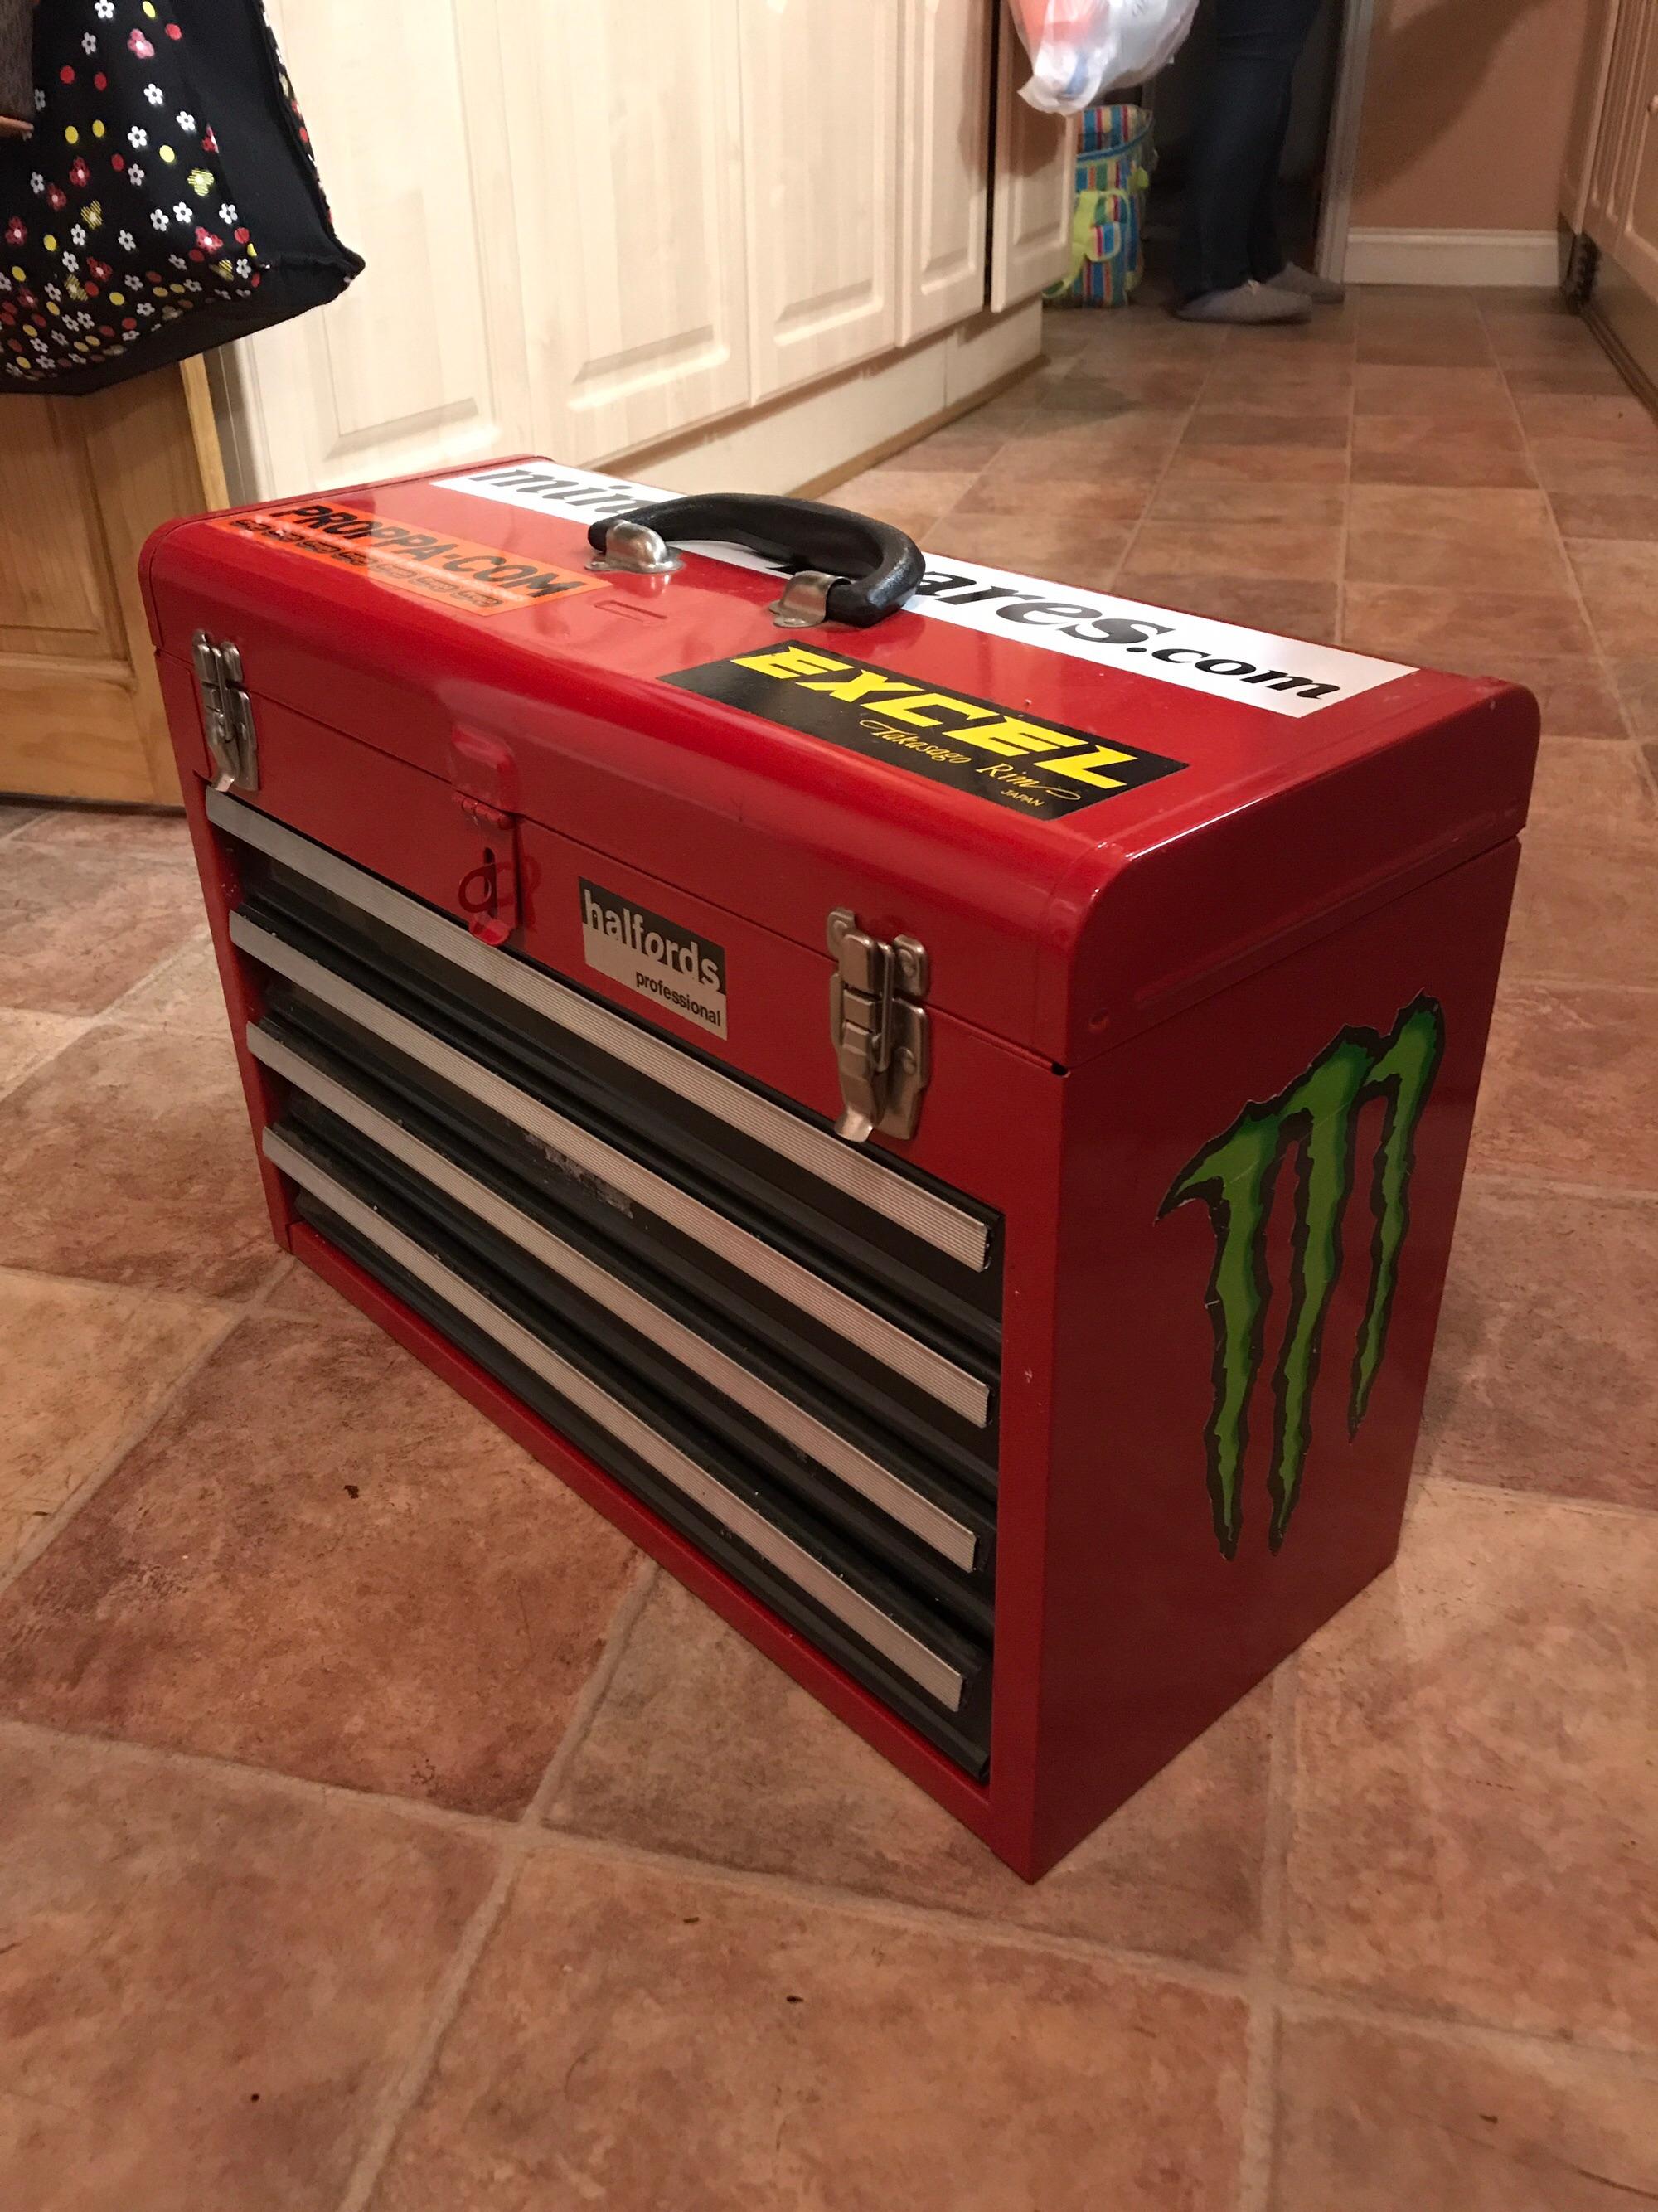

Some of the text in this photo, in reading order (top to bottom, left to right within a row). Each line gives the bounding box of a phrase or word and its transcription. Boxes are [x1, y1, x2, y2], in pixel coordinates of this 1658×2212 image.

[730, 647, 1138, 789] EXCEL
[859, 720, 972, 764] Takasago
[1001, 789, 1045, 807] JAPAN
[584, 889, 722, 993] halfords
[635, 971, 720, 1027] professional
